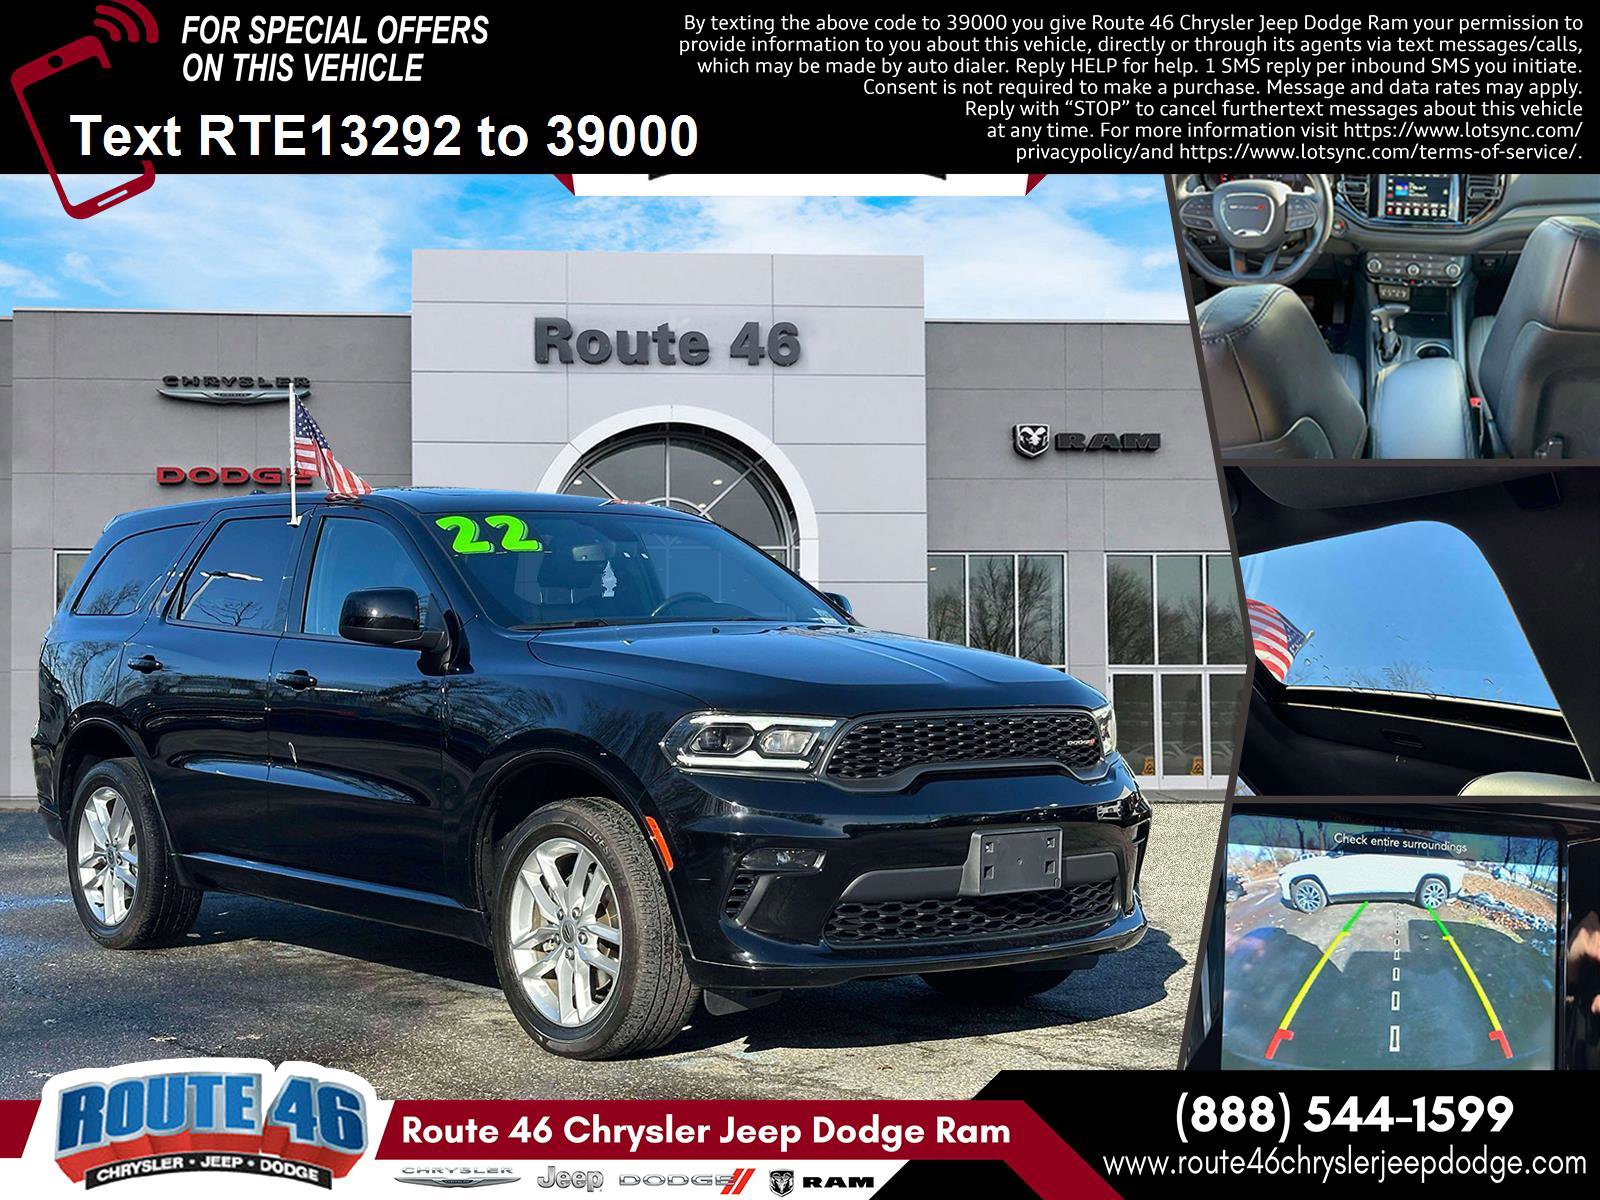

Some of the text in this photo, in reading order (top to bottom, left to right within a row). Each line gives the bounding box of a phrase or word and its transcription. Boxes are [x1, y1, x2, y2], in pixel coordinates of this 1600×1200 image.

[534, 317, 801, 366] Route 46
[162, 375, 311, 388] CHRYSLER
[1055, 433, 1161, 452] RAM
[435, 515, 543, 554] 22
[1334, 832, 1468, 855] Check entire surroundings
